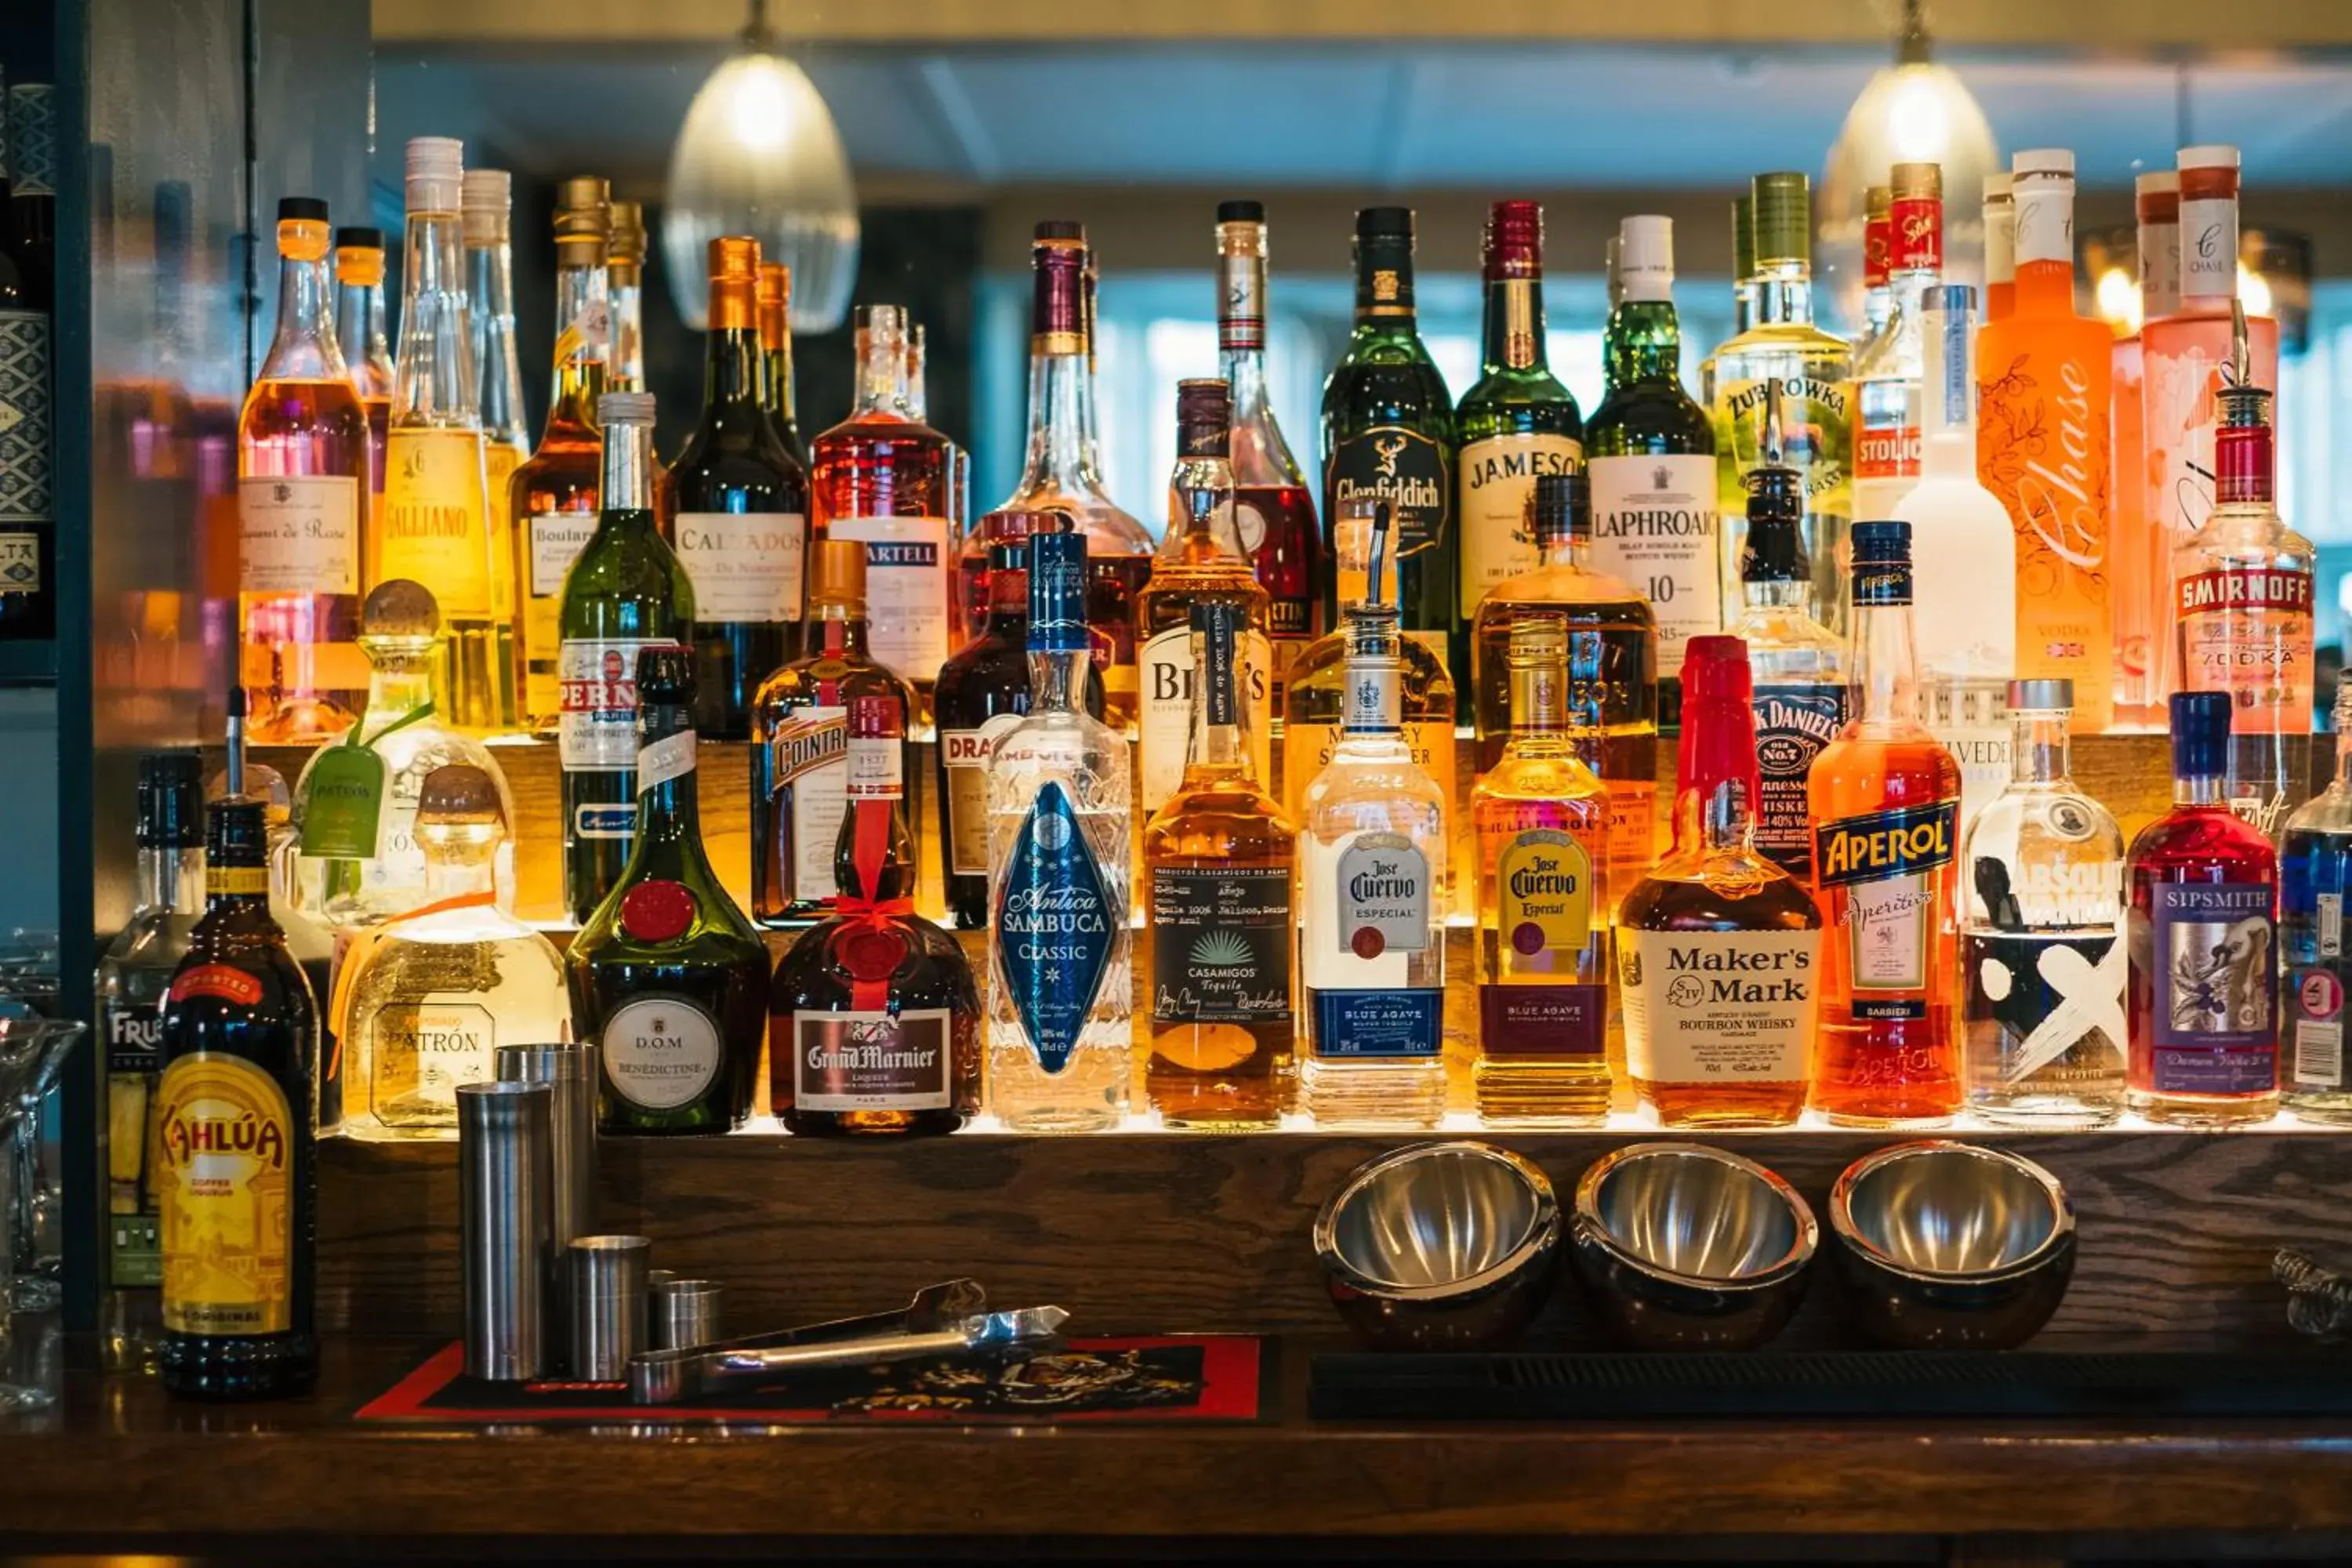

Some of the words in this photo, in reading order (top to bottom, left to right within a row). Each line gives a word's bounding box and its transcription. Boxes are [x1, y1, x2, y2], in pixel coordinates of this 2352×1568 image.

[1729, 376, 1846, 420] ŻUBÓWKA
[1860, 440, 1922, 463] STOLIC
[1471, 451, 1577, 489] JAMESO
[2016, 357, 2104, 570] Chase
[536, 528, 597, 543] Boular
[681, 528, 801, 552] CALADOS
[867, 546, 935, 562] ARTELL
[1647, 575, 1674, 603] 10
[2182, 575, 2308, 609] SMIRNOFF
[561, 684, 637, 707] PERN
[779, 725, 848, 776] COINTR
[1827, 814, 1948, 876] APEROL
[1007, 880, 1098, 913] Antica
[1348, 873, 1416, 904] Cuervo
[1510, 870, 1577, 900] Cuervo
[2166, 891, 2267, 908] SIPSMITH
[1004, 913, 1105, 934] SAMBUCA
[1356, 909, 1414, 919] ESPECIAL
[1018, 943, 1087, 961] CLASSIC
[1666, 947, 1809, 971] Maker's
[1188, 967, 1256, 978] CASAMIGOS
[1708, 978, 1807, 1003] Mark
[1345, 1011, 1377, 1020] BLUE
[1381, 1010, 1423, 1019] AGAVE
[1507, 1007, 1539, 1016] BLUE
[1542, 1006, 1582, 1016] AGAVE
[1679, 1019, 1744, 1031] BOURBON
[1747, 1018, 1796, 1029] WHISKY
[387, 1029, 479, 1052] PATRÓN
